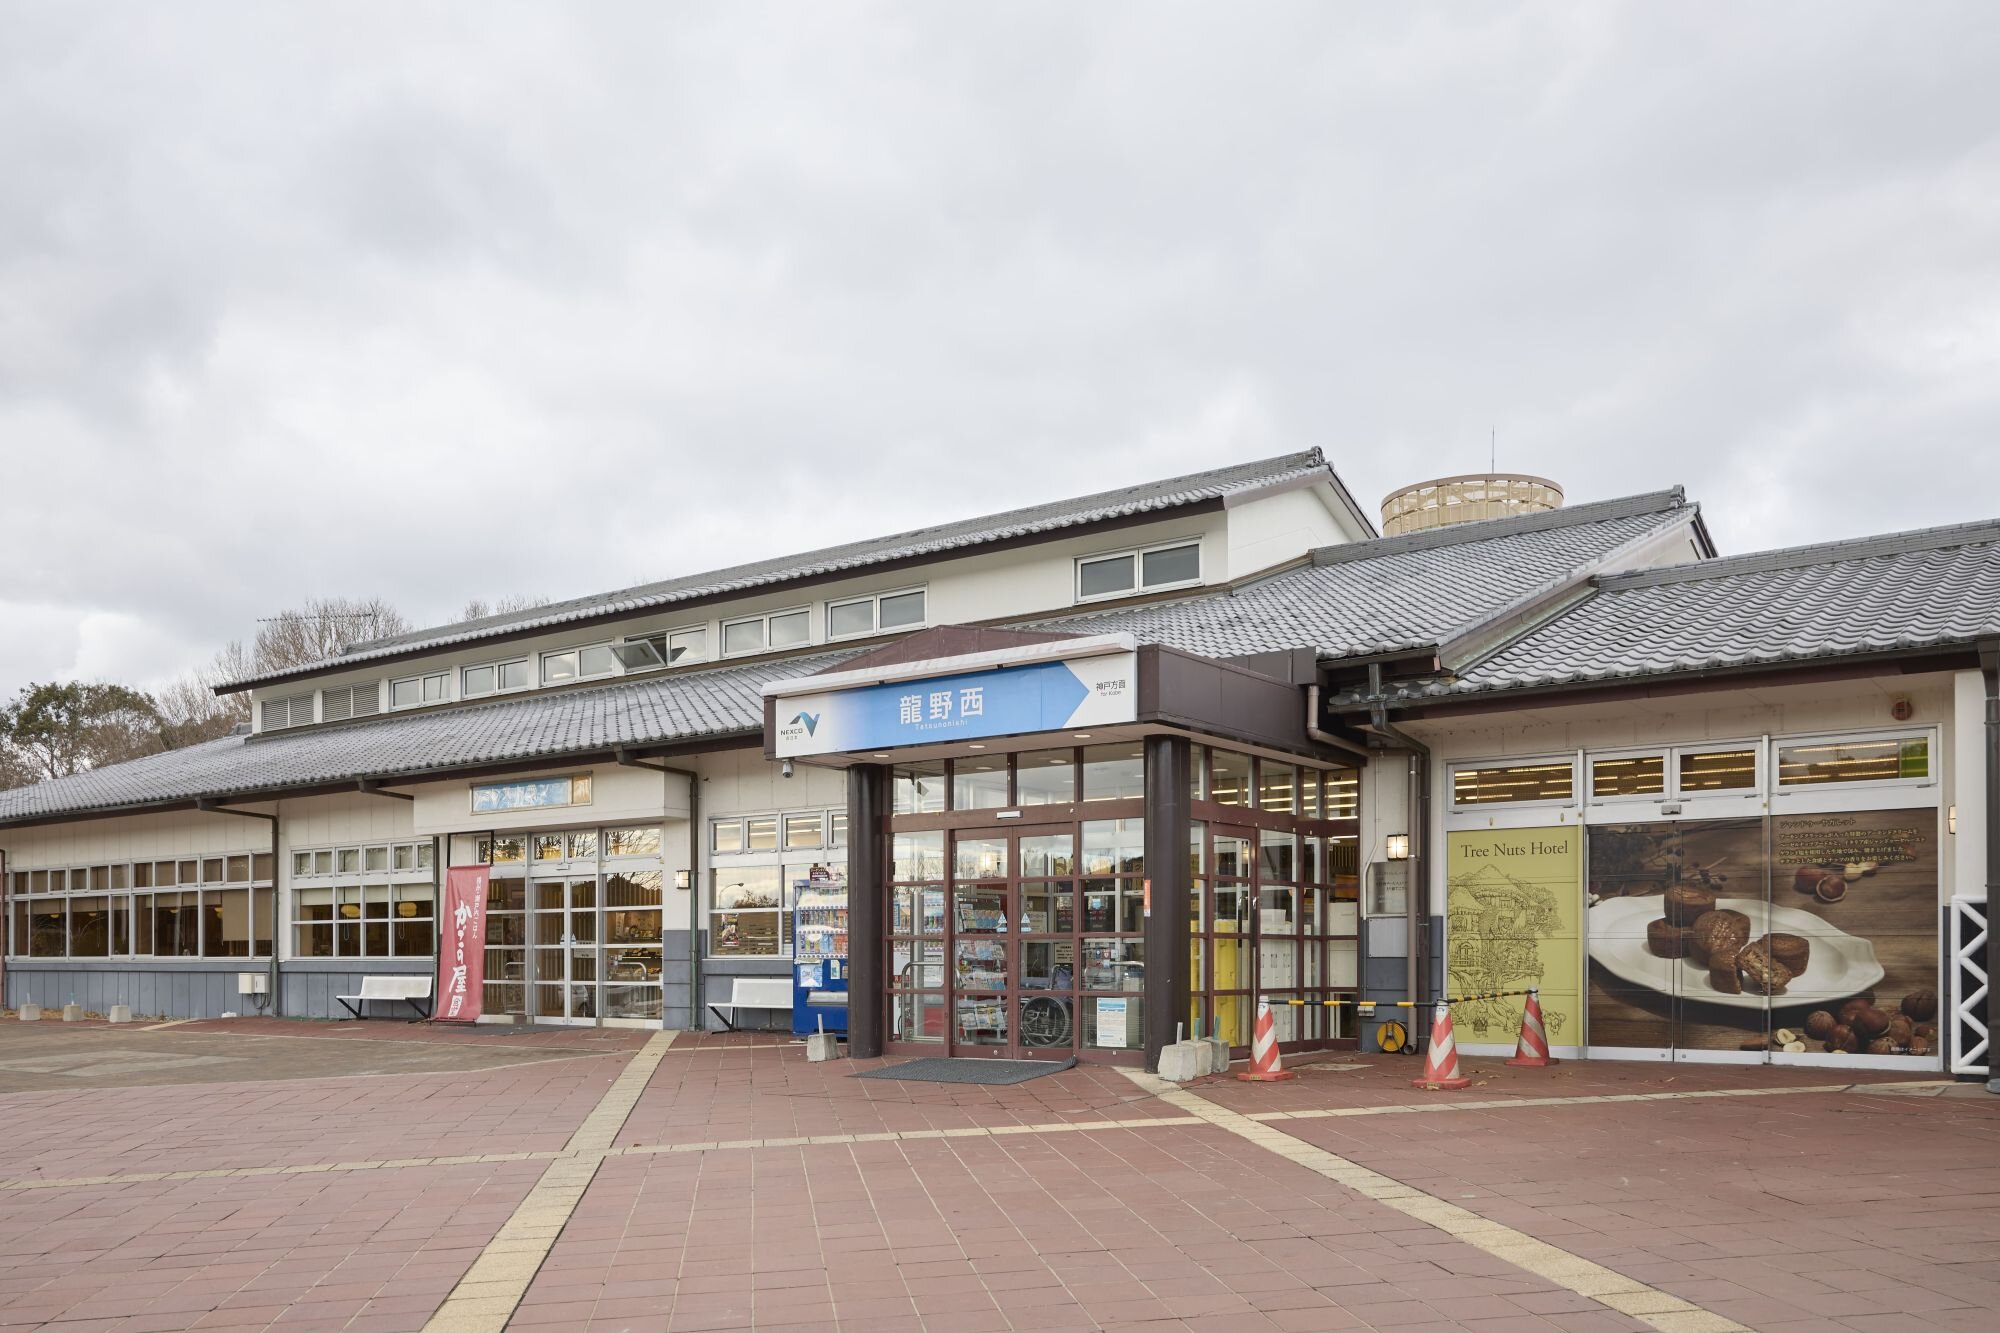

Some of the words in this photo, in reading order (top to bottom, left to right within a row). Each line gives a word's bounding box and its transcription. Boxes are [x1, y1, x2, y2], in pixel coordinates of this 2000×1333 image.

[1096, 679, 1125, 691] 神戸方面
[899, 687, 984, 725] 龍野西
[915, 719, 968, 730] Tatsunonishi
[1460, 844, 1489, 858] Tree
[1493, 843, 1526, 857] Nuts
[1531, 840, 1568, 855] Hotel
